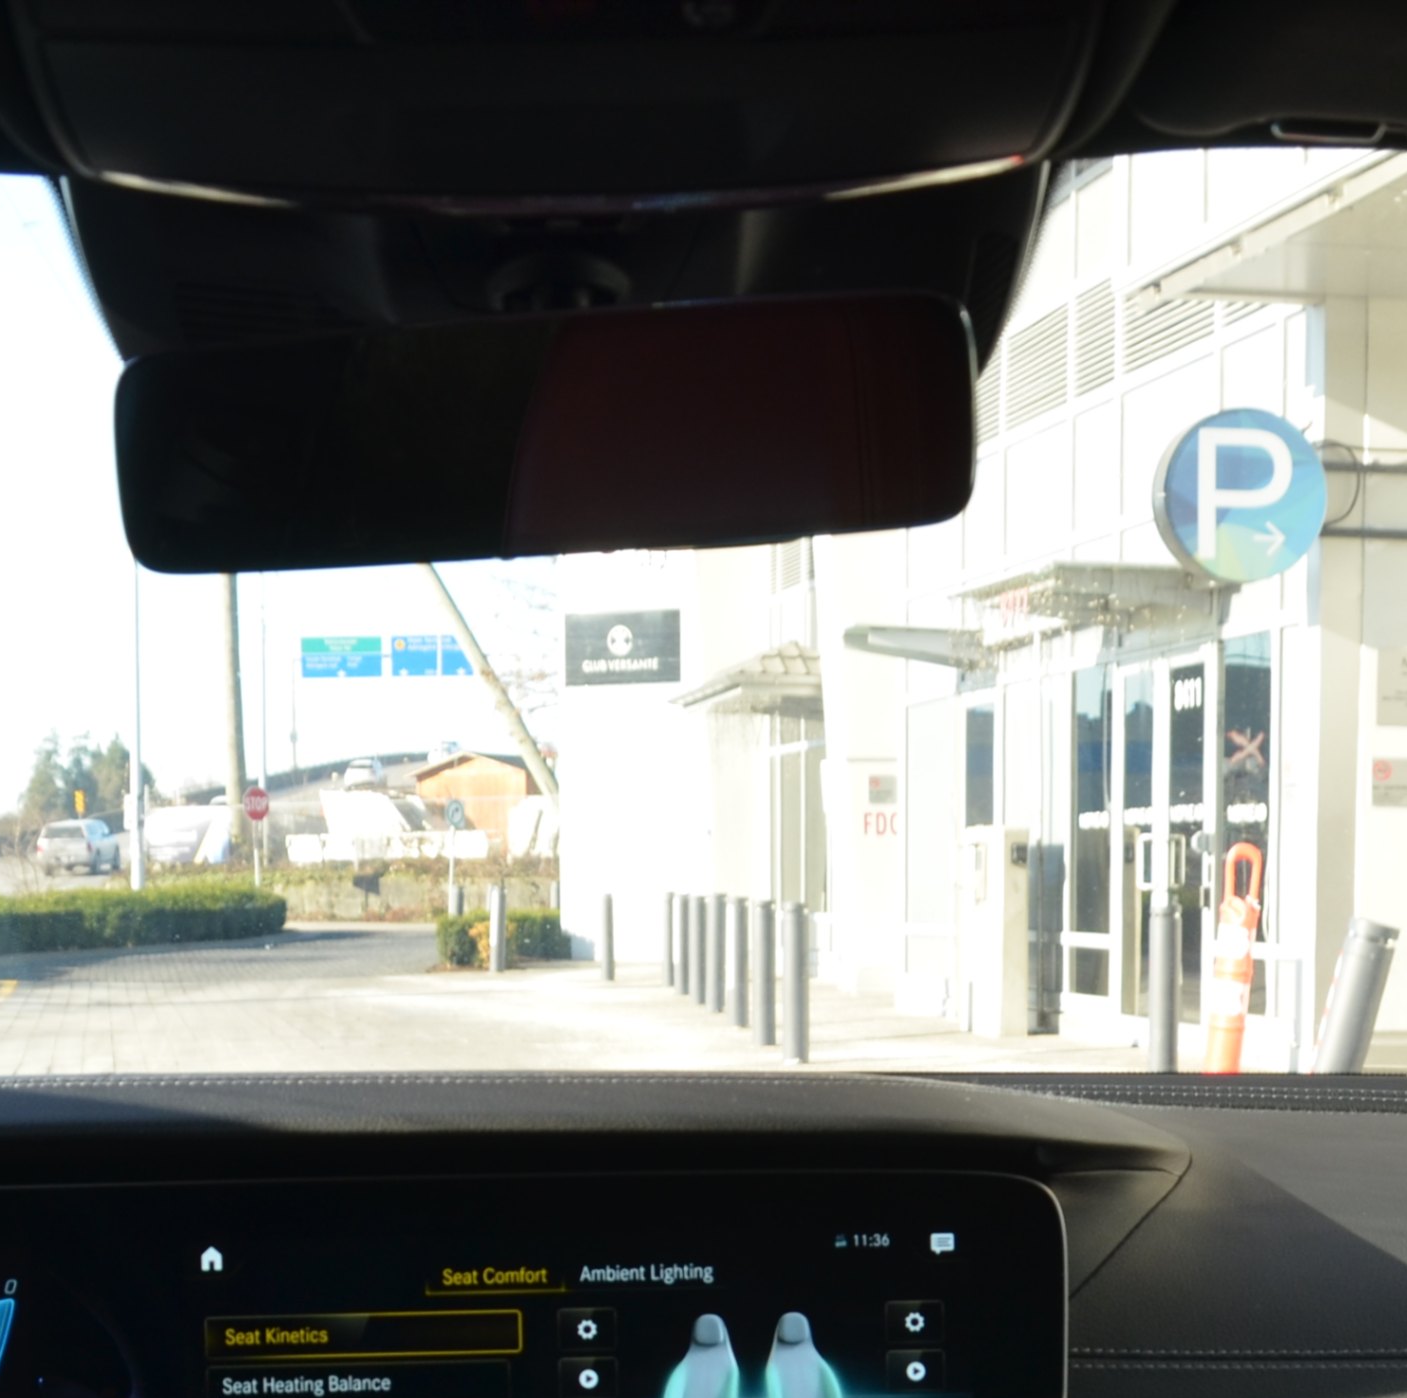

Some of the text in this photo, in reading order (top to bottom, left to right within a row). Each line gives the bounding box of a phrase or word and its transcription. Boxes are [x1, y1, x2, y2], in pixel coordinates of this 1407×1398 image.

[1197, 428, 1292, 560] P
[582, 659, 607, 673] CLUB
[245, 796, 268, 811] STOP
[853, 1233, 890, 1247] 11:36
[442, 1267, 547, 1285] Seat Comfort
[580, 1262, 714, 1285] Ambient Lighting
[225, 1326, 328, 1346] Seat Kinetics
[222, 1375, 391, 1397] Seat Heating Balance
